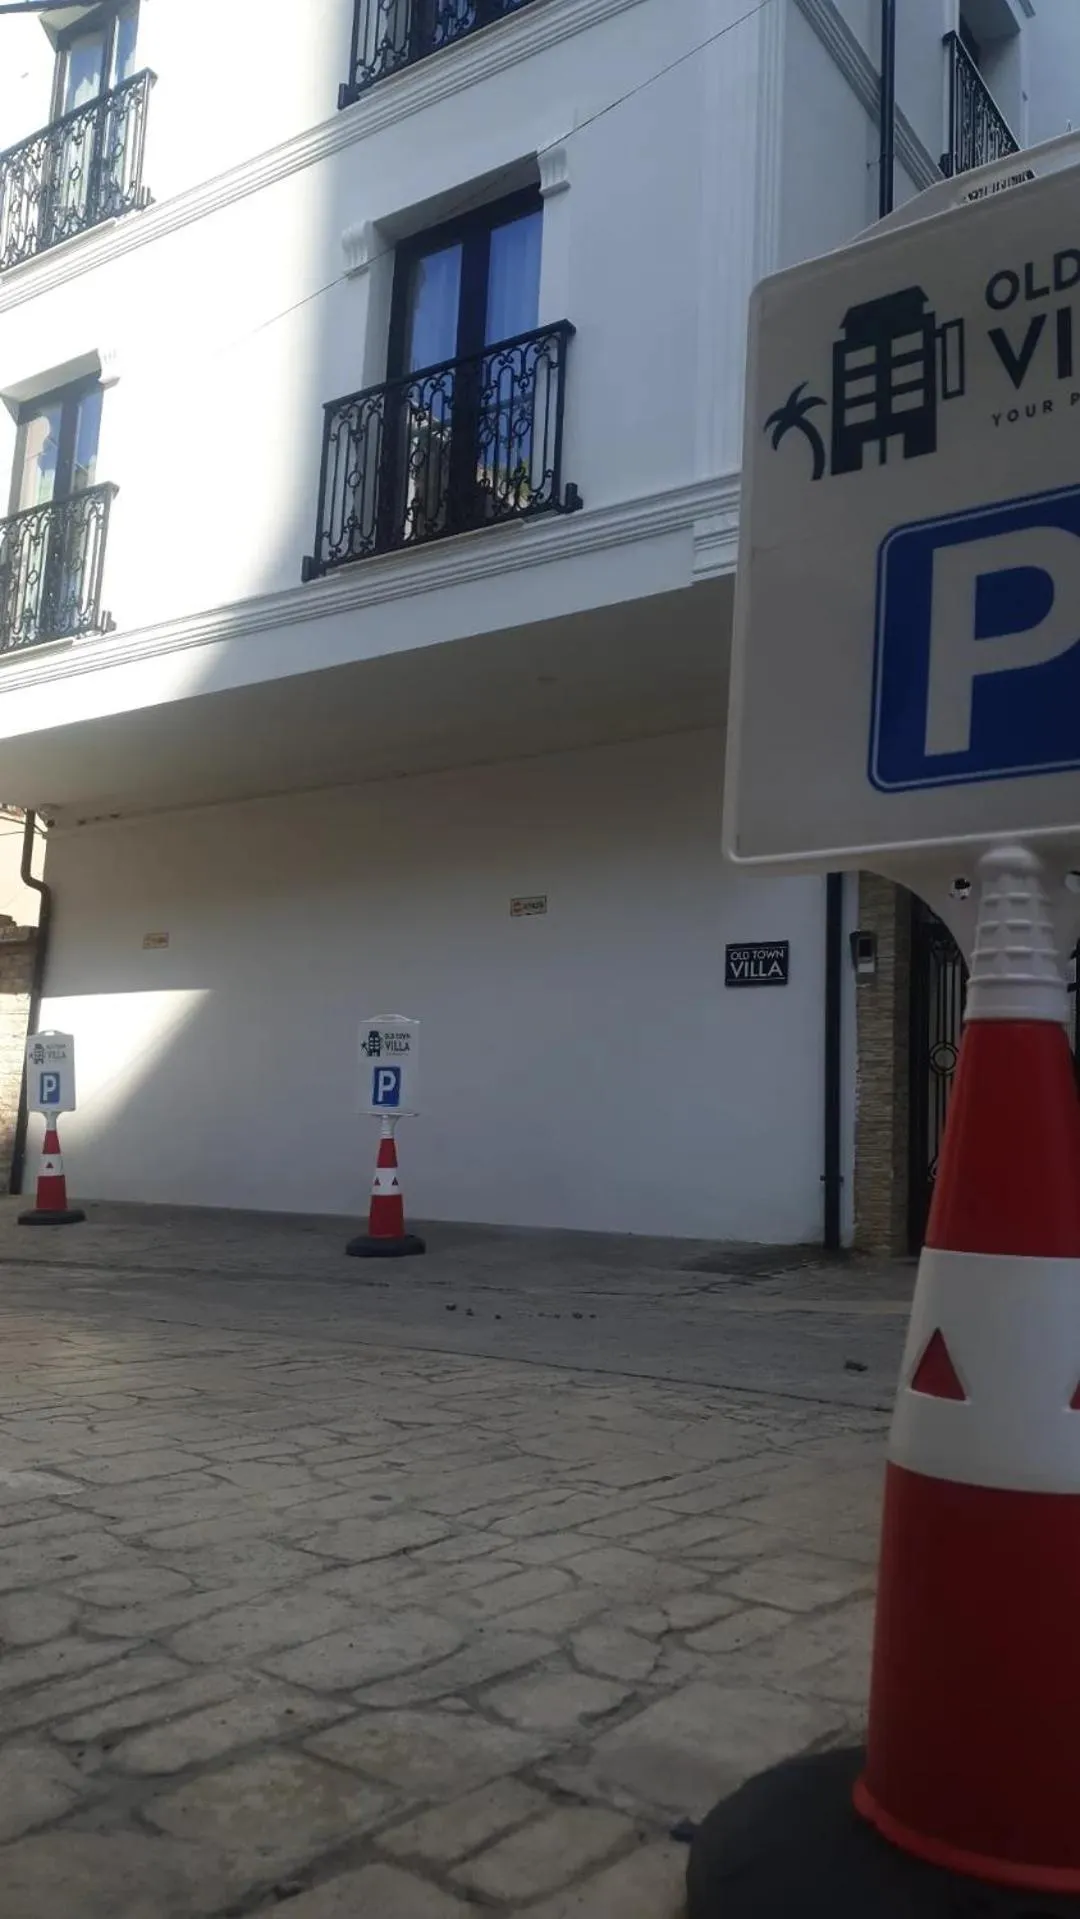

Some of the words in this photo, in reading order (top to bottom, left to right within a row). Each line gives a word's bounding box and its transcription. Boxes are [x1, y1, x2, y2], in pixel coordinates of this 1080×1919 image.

[985, 248, 1080, 310] OLD
[991, 399, 1053, 427] YOUR
[925, 526, 1080, 757] P
[730, 951, 749, 960] OLD
[752, 949, 784, 960] TOWN
[730, 960, 784, 978] VILLA
[385, 1040, 411, 1052] VILLA
[42, 1074, 57, 1102] P
[378, 1070, 396, 1102] P
